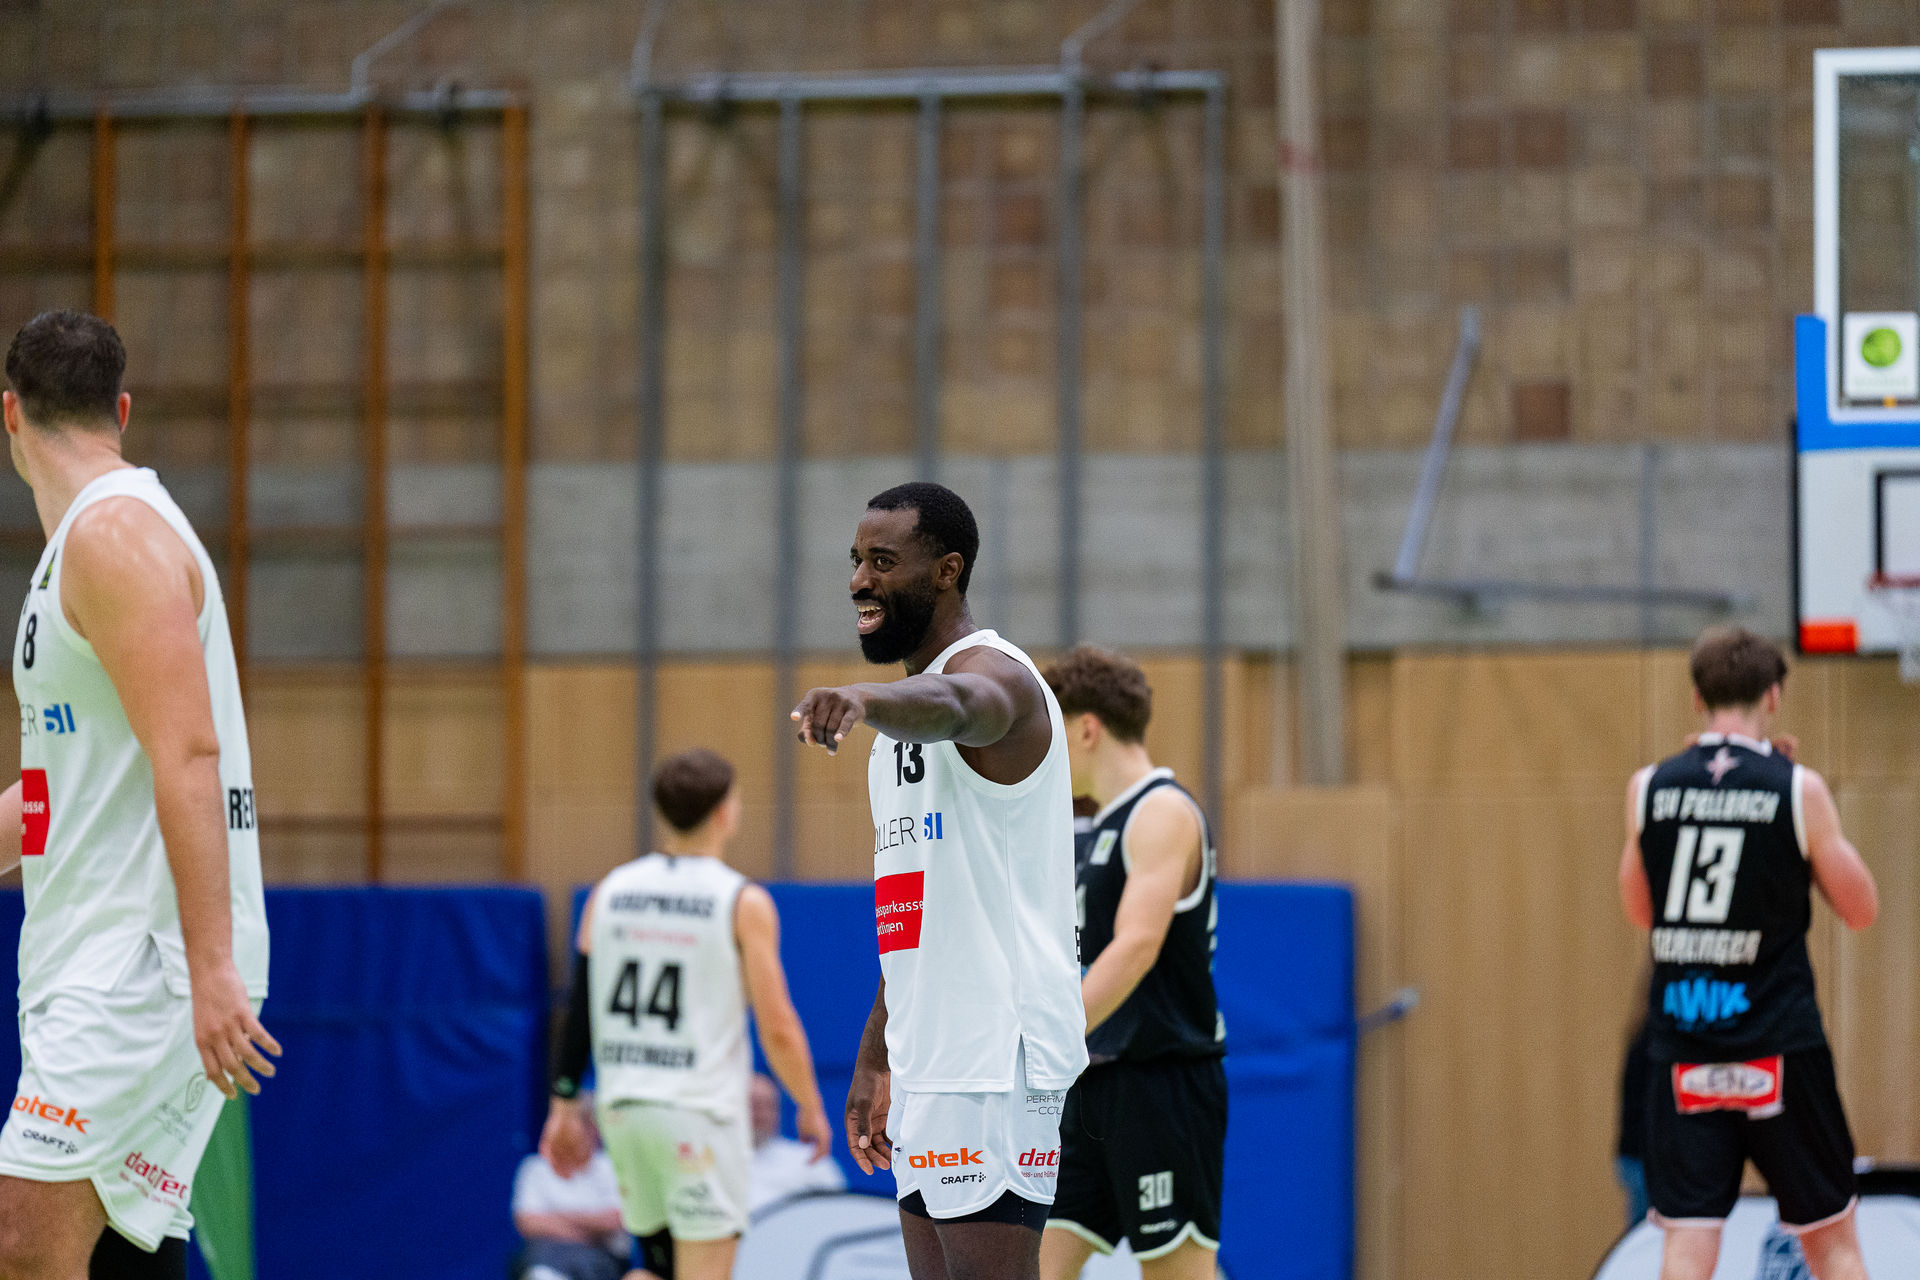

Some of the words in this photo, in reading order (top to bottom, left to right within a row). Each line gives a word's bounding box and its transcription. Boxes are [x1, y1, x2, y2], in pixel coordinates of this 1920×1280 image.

[893, 742, 925, 787] 13
[1663, 825, 1745, 924] 13
[608, 960, 681, 1031] 44
[12, 1095, 91, 1134] otek
[908, 1147, 984, 1169] otek
[941, 1174, 977, 1185] CRAFT
[1138, 1170, 1174, 1212] 30
